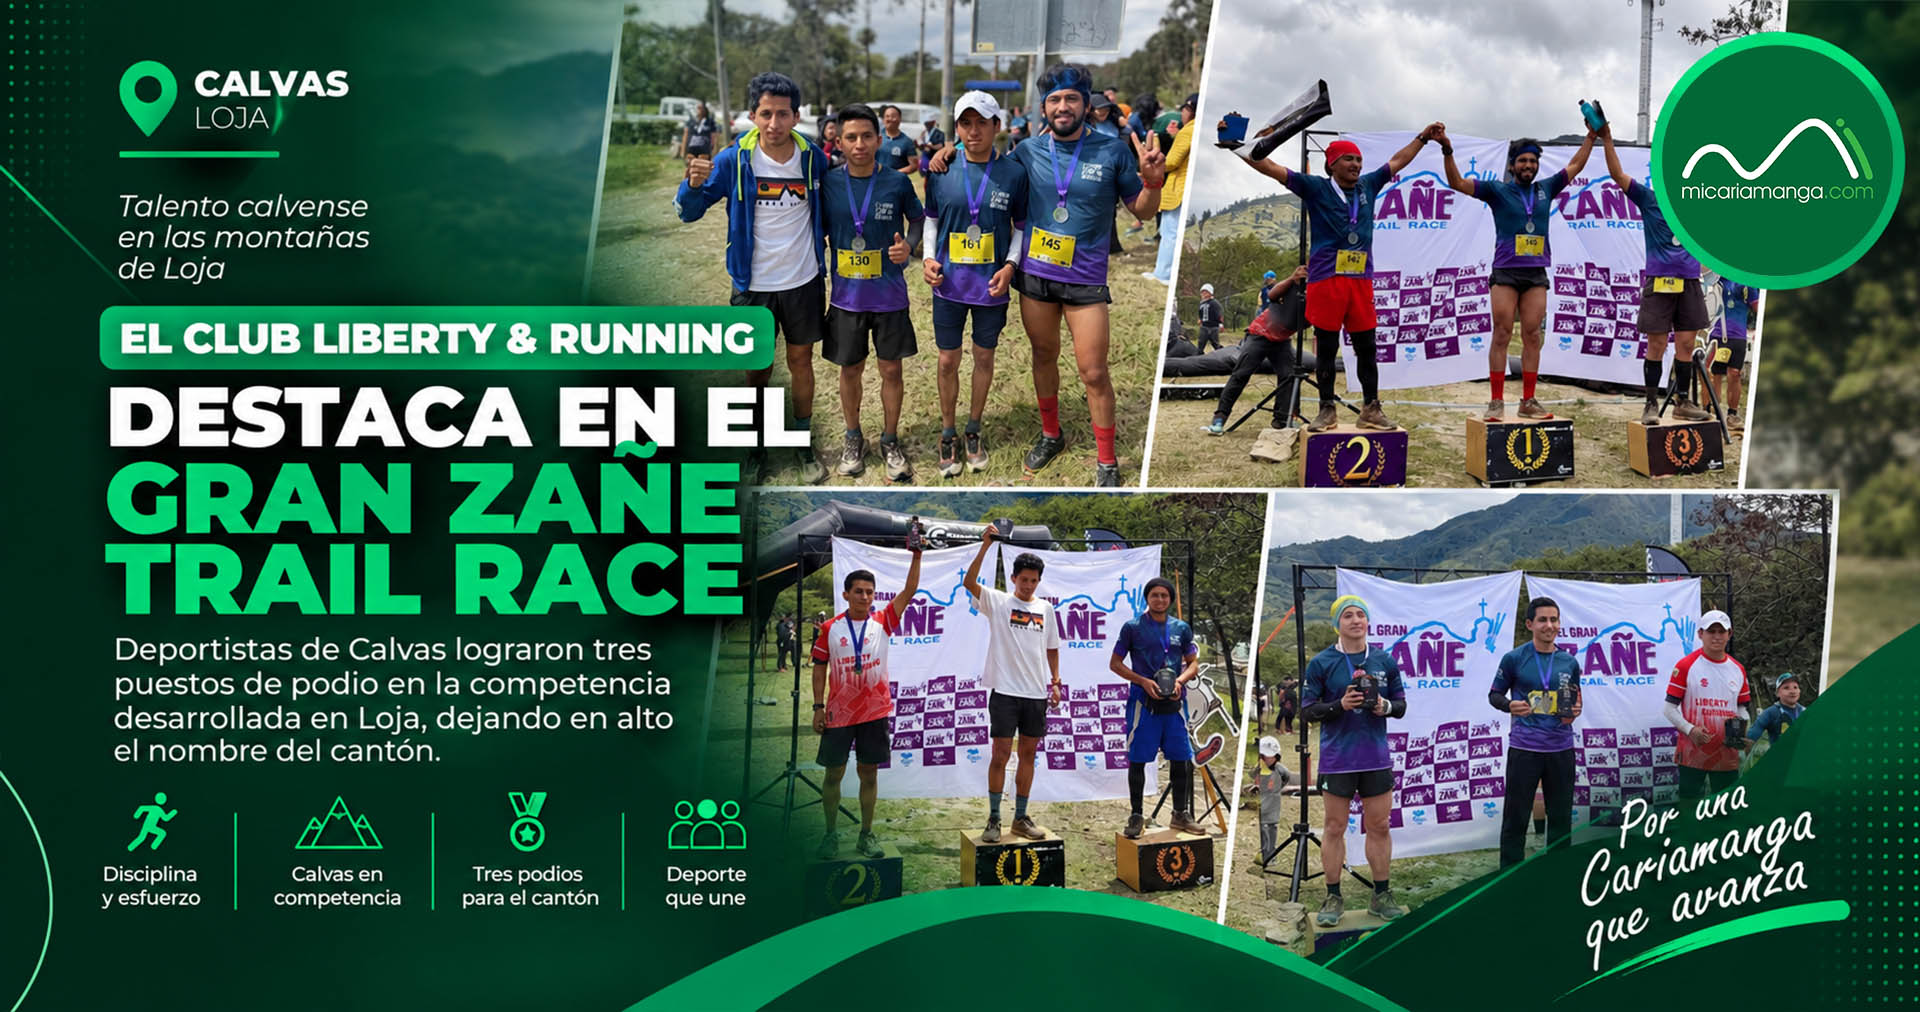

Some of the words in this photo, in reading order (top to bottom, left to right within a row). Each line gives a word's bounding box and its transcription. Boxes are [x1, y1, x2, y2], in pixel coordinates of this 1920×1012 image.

[1372, 179, 1455, 221] AÑE
[1408, 220, 1448, 230] RACE
[961, 239, 981, 249] 161
[1041, 236, 1062, 251] 145
[849, 255, 870, 266] 130
[1521, 427, 1533, 455] 1
[1677, 429, 1691, 453] 3
[1344, 435, 1371, 479] 2
[1367, 625, 1375, 636] L
[1376, 624, 1408, 637] GRAN
[1569, 627, 1598, 638] GRAN
[903, 635, 941, 645] RACE
[1068, 641, 1104, 649] RACE
[1368, 631, 1466, 678] AÑE
[1417, 679, 1461, 689] RACE
[1615, 676, 1656, 686] RACE
[1012, 849, 1022, 876] 1
[1169, 846, 1182, 871] 3
